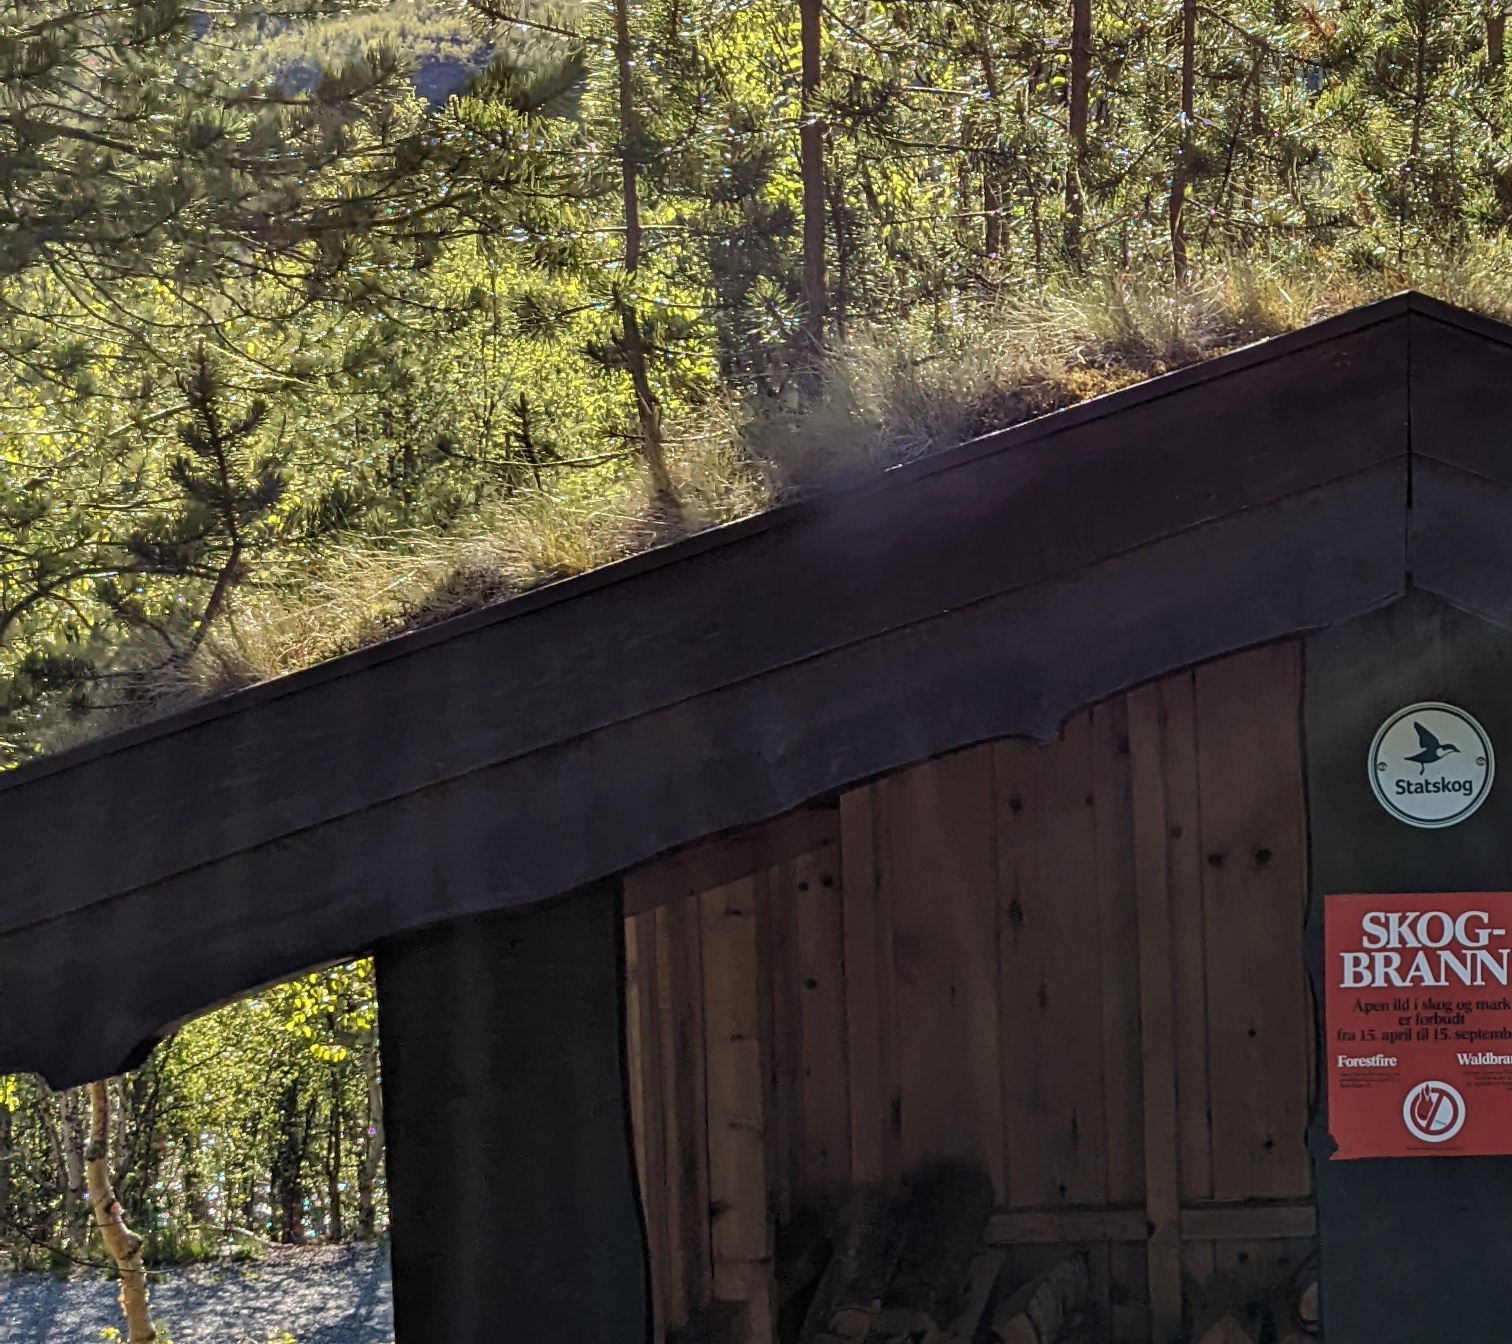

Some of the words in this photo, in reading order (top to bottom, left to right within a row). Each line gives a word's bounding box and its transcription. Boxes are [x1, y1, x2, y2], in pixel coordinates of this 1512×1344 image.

[1395, 777, 1473, 796] Statskog
[1362, 910, 1506, 949] SKOG-
[1394, 997, 1409, 1011] ild
[1414, 997, 1418, 1011] i
[1422, 997, 1453, 1014] skog
[1456, 1001, 1472, 1014] og
[1476, 997, 1511, 1010] mark
[1398, 1016, 1412, 1026] er
[1416, 1011, 1465, 1026] forbudt
[1337, 1027, 1355, 1041] fra
[1381, 1027, 1412, 1043] april
[1417, 1027, 1429, 1041] til
[1434, 1028, 1451, 1040] 15.
[1337, 1053, 1398, 1068] Forestfire
